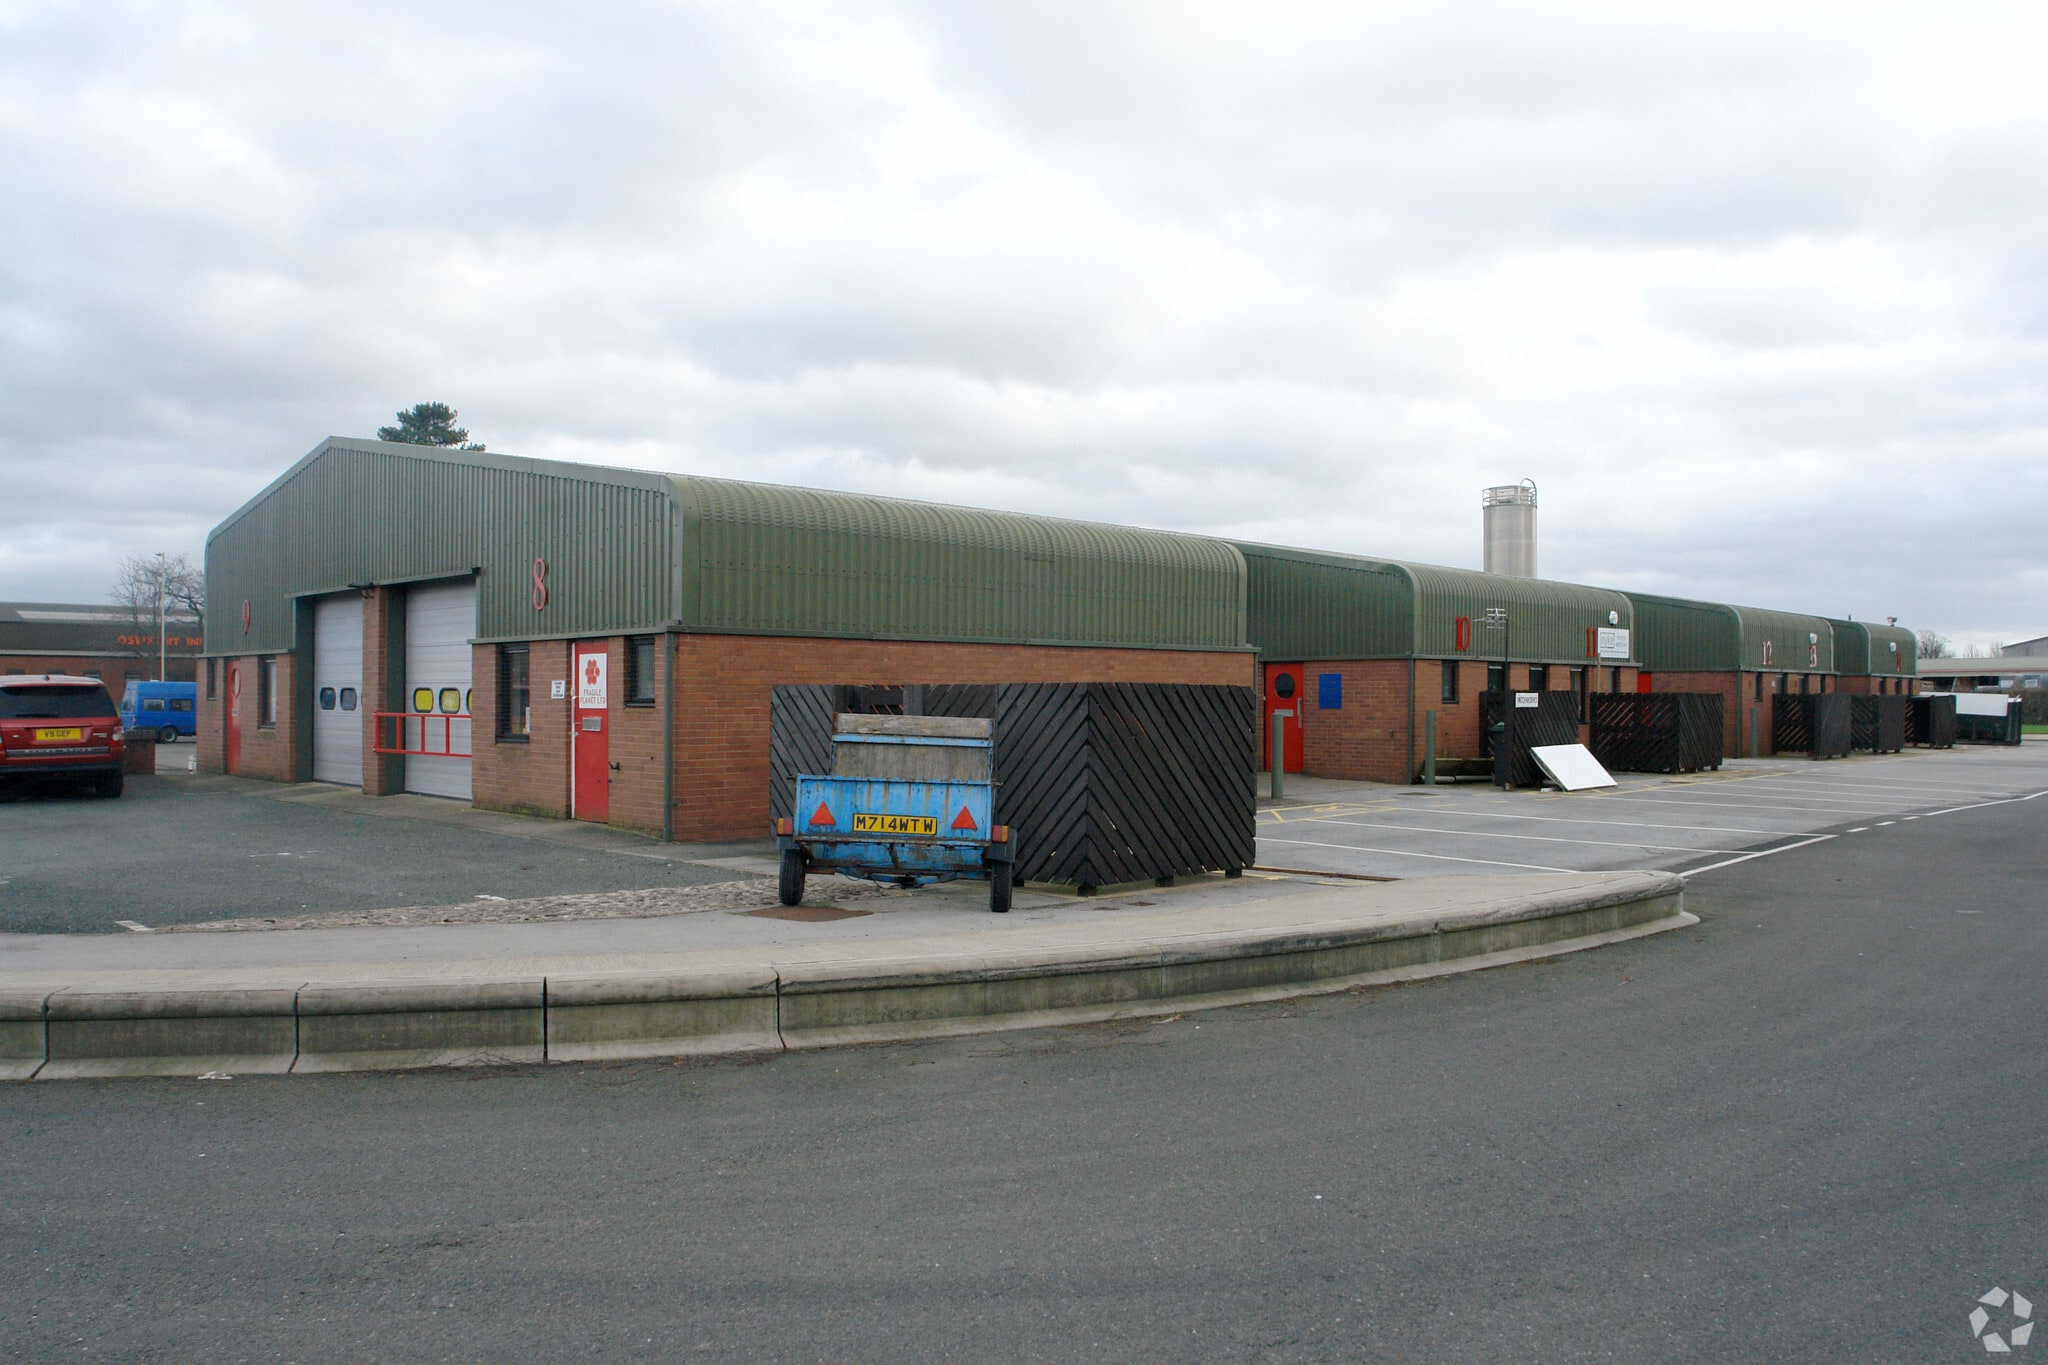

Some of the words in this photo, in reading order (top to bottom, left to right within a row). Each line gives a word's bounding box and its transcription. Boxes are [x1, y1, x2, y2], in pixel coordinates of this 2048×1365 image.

[532, 557, 546, 610] 8
[241, 599, 250, 635] 9
[1455, 615, 1471, 652] 10
[1586, 626, 1597, 657] 11
[1762, 640, 1772, 665] 12
[856, 816, 934, 832] M714WTW
